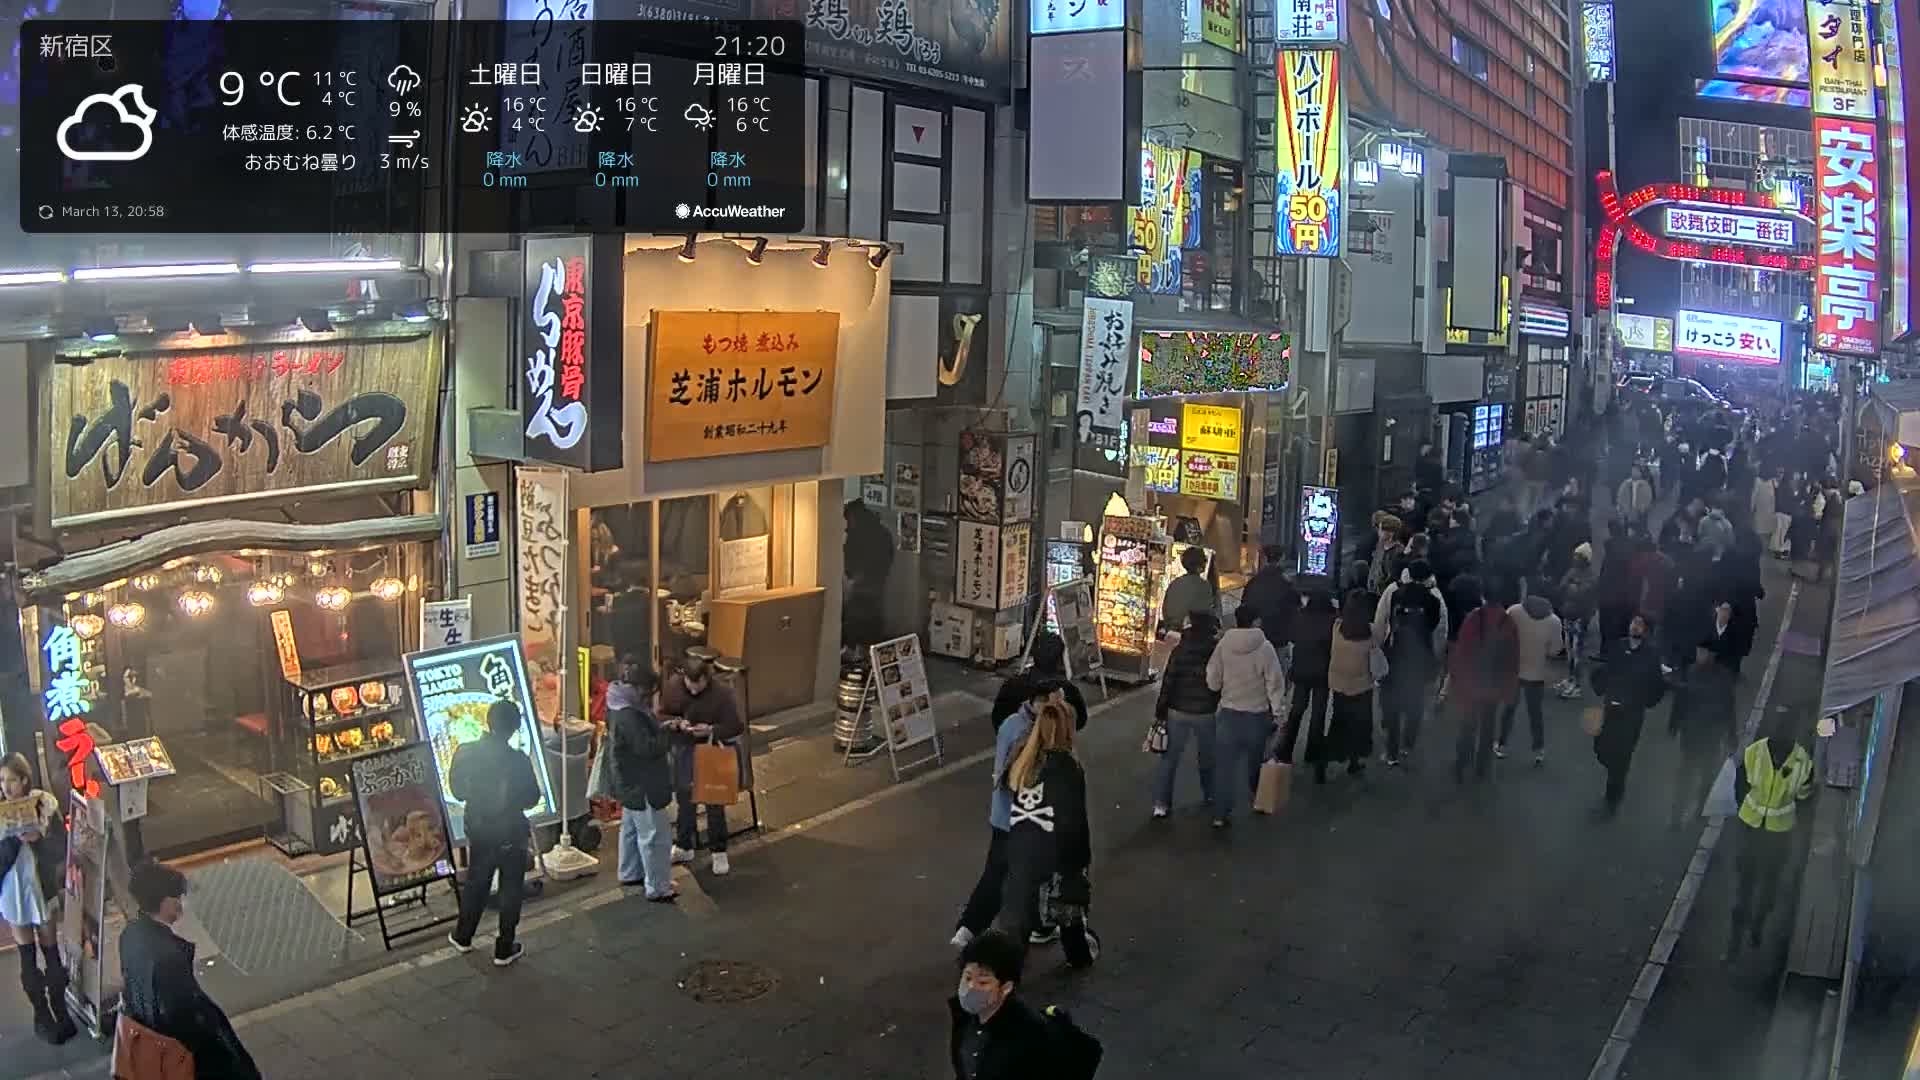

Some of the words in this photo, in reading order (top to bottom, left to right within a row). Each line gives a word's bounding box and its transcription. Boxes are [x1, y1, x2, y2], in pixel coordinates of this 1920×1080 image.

[1589, 63, 1610, 79] 7F
[1832, 97, 1856, 112] 3F
[1293, 54, 1323, 190] ハイボール
[1289, 195, 1327, 221] 50
[1295, 224, 1319, 251] 円
[1670, 210, 1790, 242] 歌舞伎町一番街
[1819, 126, 1877, 330] 安楽亭
[561, 256, 585, 400] 東京豚骨
[1818, 332, 1837, 347] 2F
[702, 332, 748, 354] もつ焼
[755, 331, 800, 353] 煮込み
[668, 365, 825, 406] 芝浦ホルモン
[439, 607, 456, 629] 生
